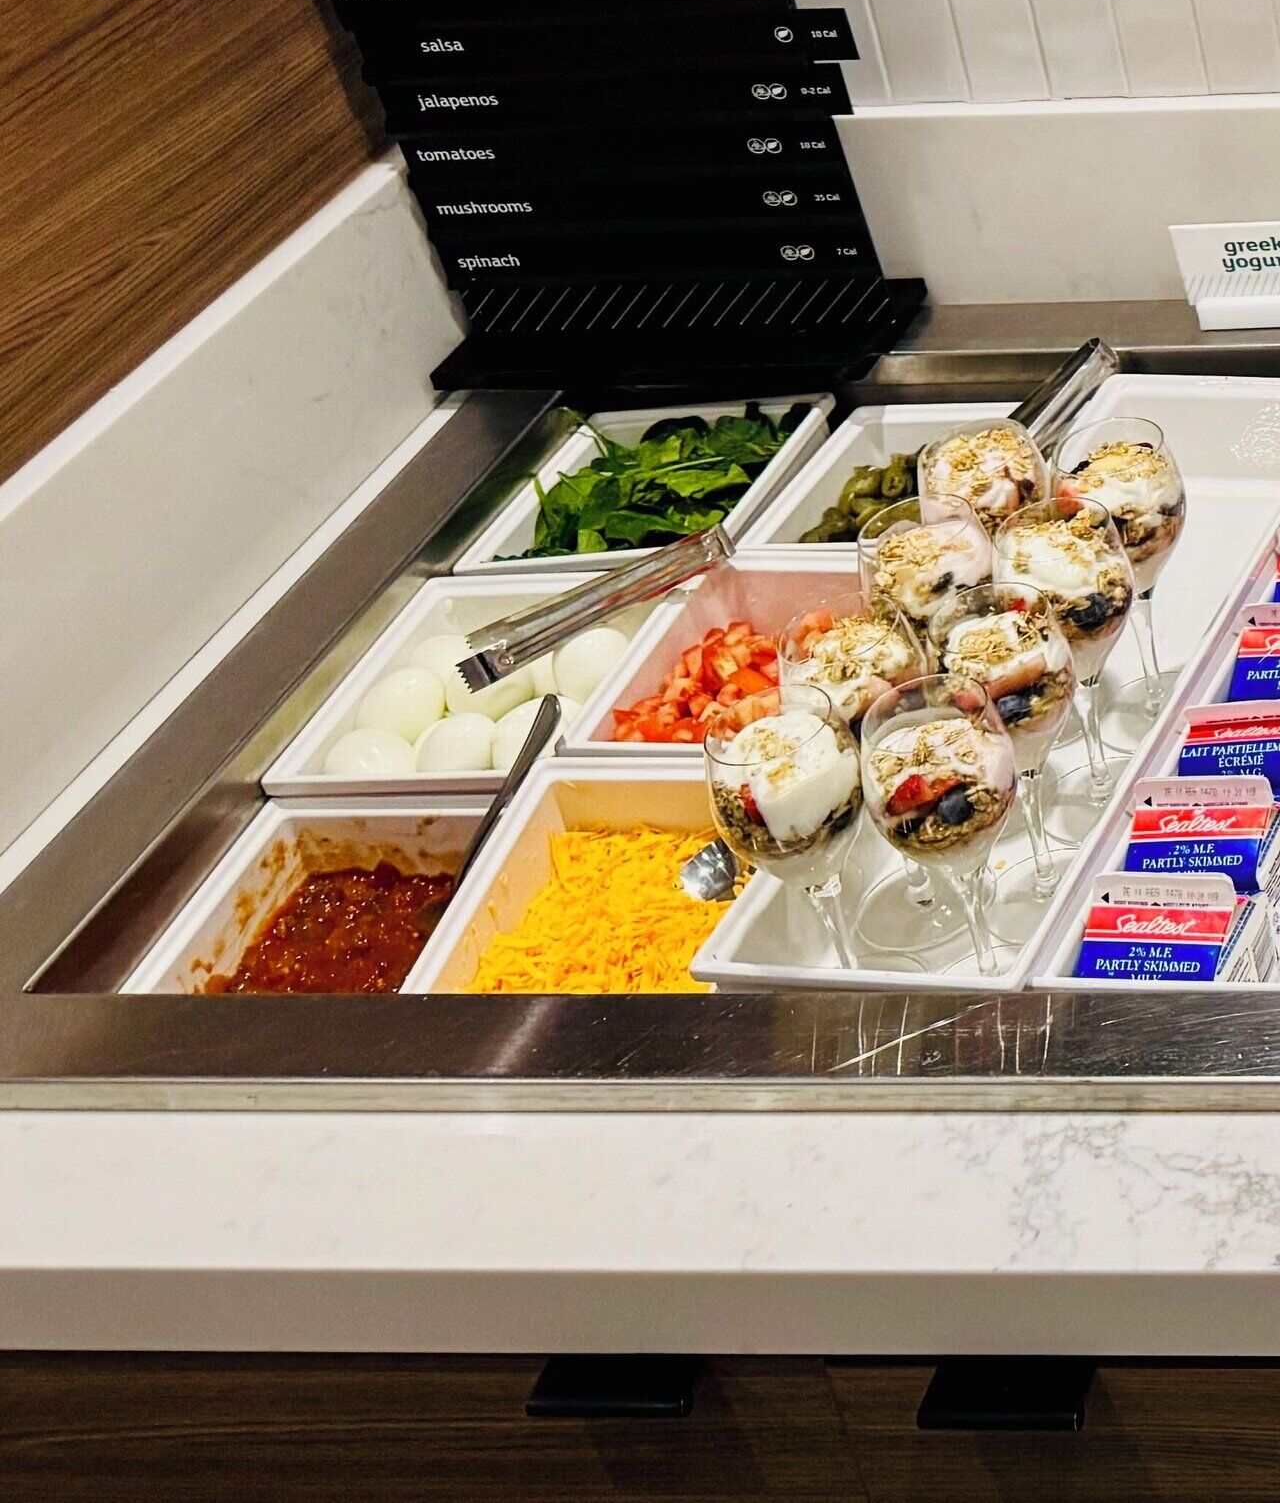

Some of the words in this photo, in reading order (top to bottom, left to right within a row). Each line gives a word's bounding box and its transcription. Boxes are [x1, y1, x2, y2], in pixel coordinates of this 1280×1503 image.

[810, 30, 823, 38] 10
[822, 29, 838, 38] Cal
[420, 38, 465, 53] salsa
[417, 94, 499, 112] jalapenos
[416, 148, 496, 162] tomatoes
[436, 201, 533, 215] mushrooms
[457, 253, 521, 271] spinach
[1181, 746, 1211, 758] LAIT
[1158, 814, 1237, 834] Sealtest
[1173, 844, 1191, 855] 2%
[1142, 856, 1185, 870] PARTLY
[1188, 854, 1244, 868] SKIMMED
[1116, 913, 1199, 935] Sealtest
[1128, 946, 1147, 958] 2%
[1095, 958, 1141, 972] PARTLY
[1143, 959, 1201, 973] SKIMMED
